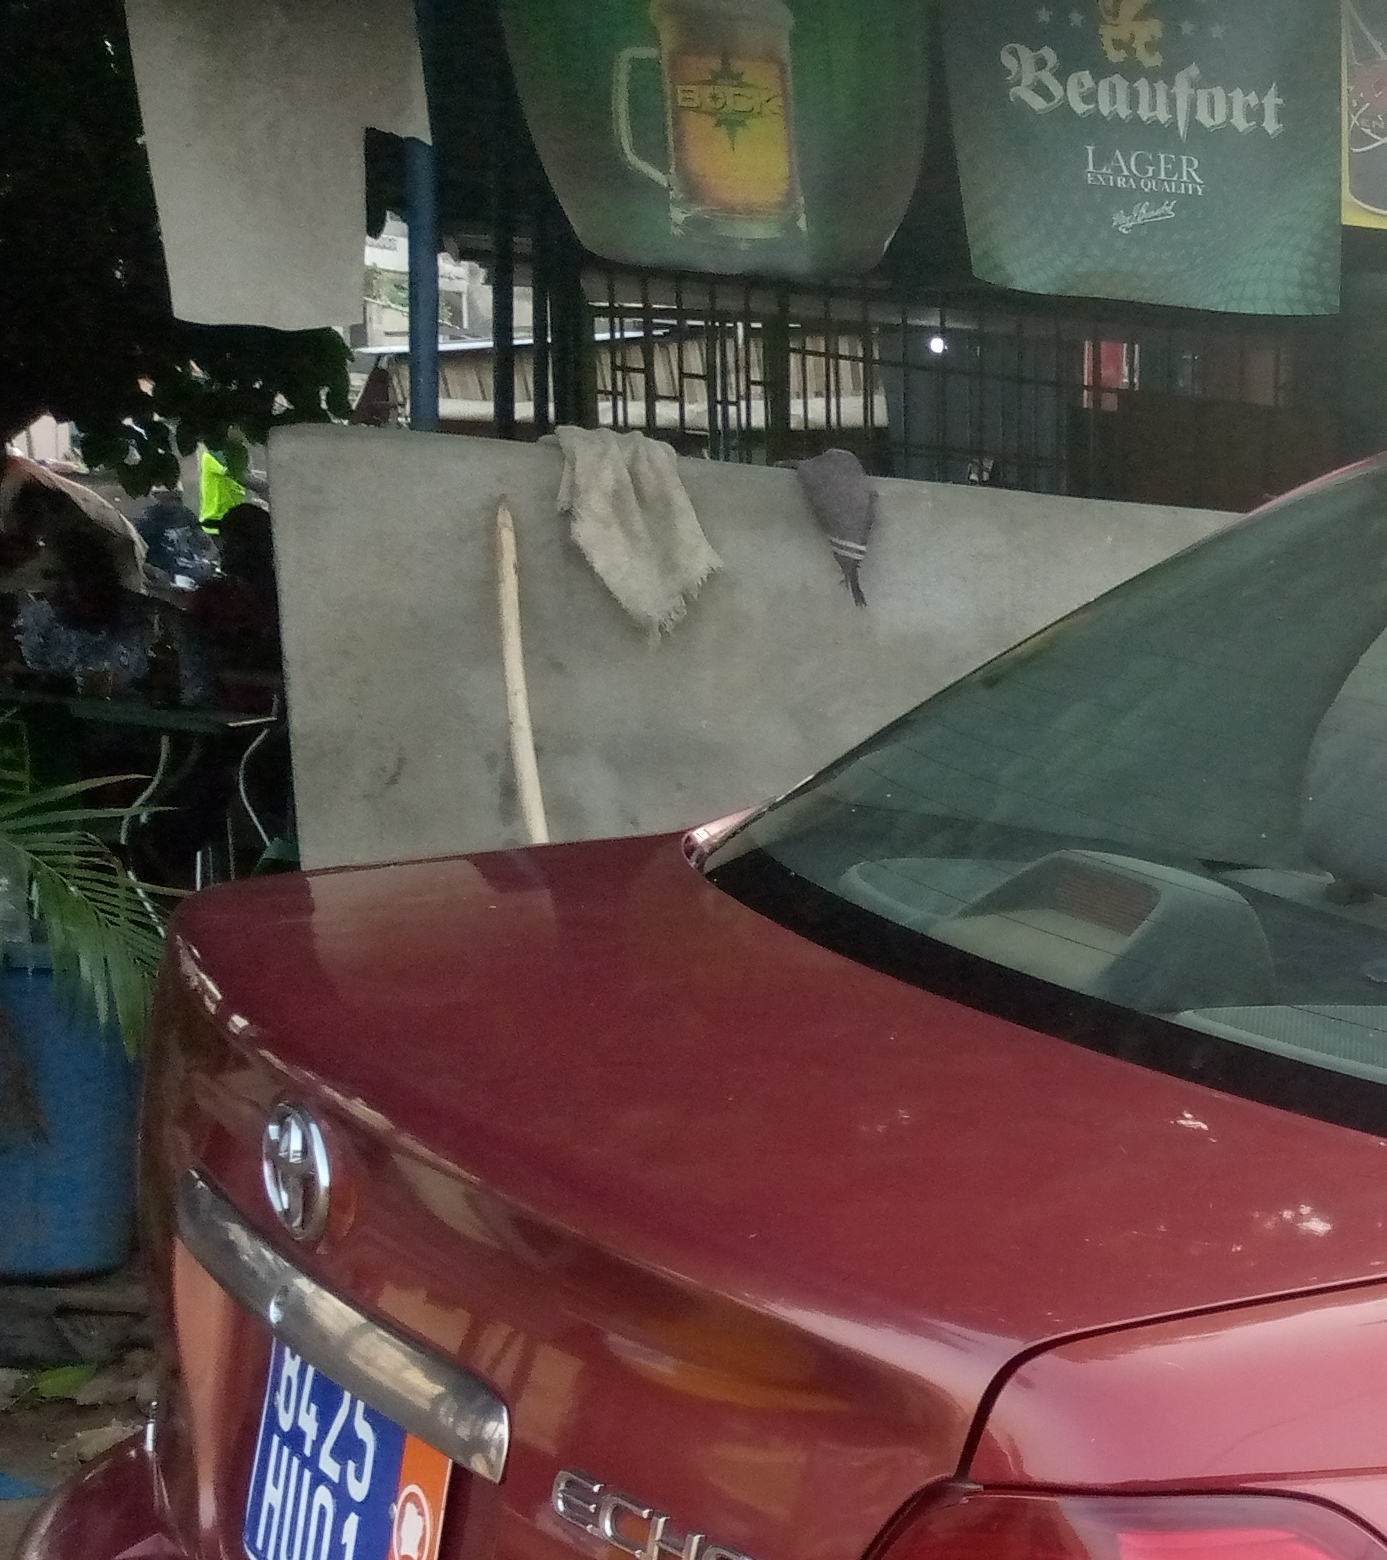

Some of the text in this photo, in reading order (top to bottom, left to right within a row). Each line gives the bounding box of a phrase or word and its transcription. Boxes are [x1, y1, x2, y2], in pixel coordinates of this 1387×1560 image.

[1000, 42, 1285, 143] Beaufort
[1085, 145, 1205, 184] LAGER
[1087, 173, 1205, 196] EXTRA QUALITY
